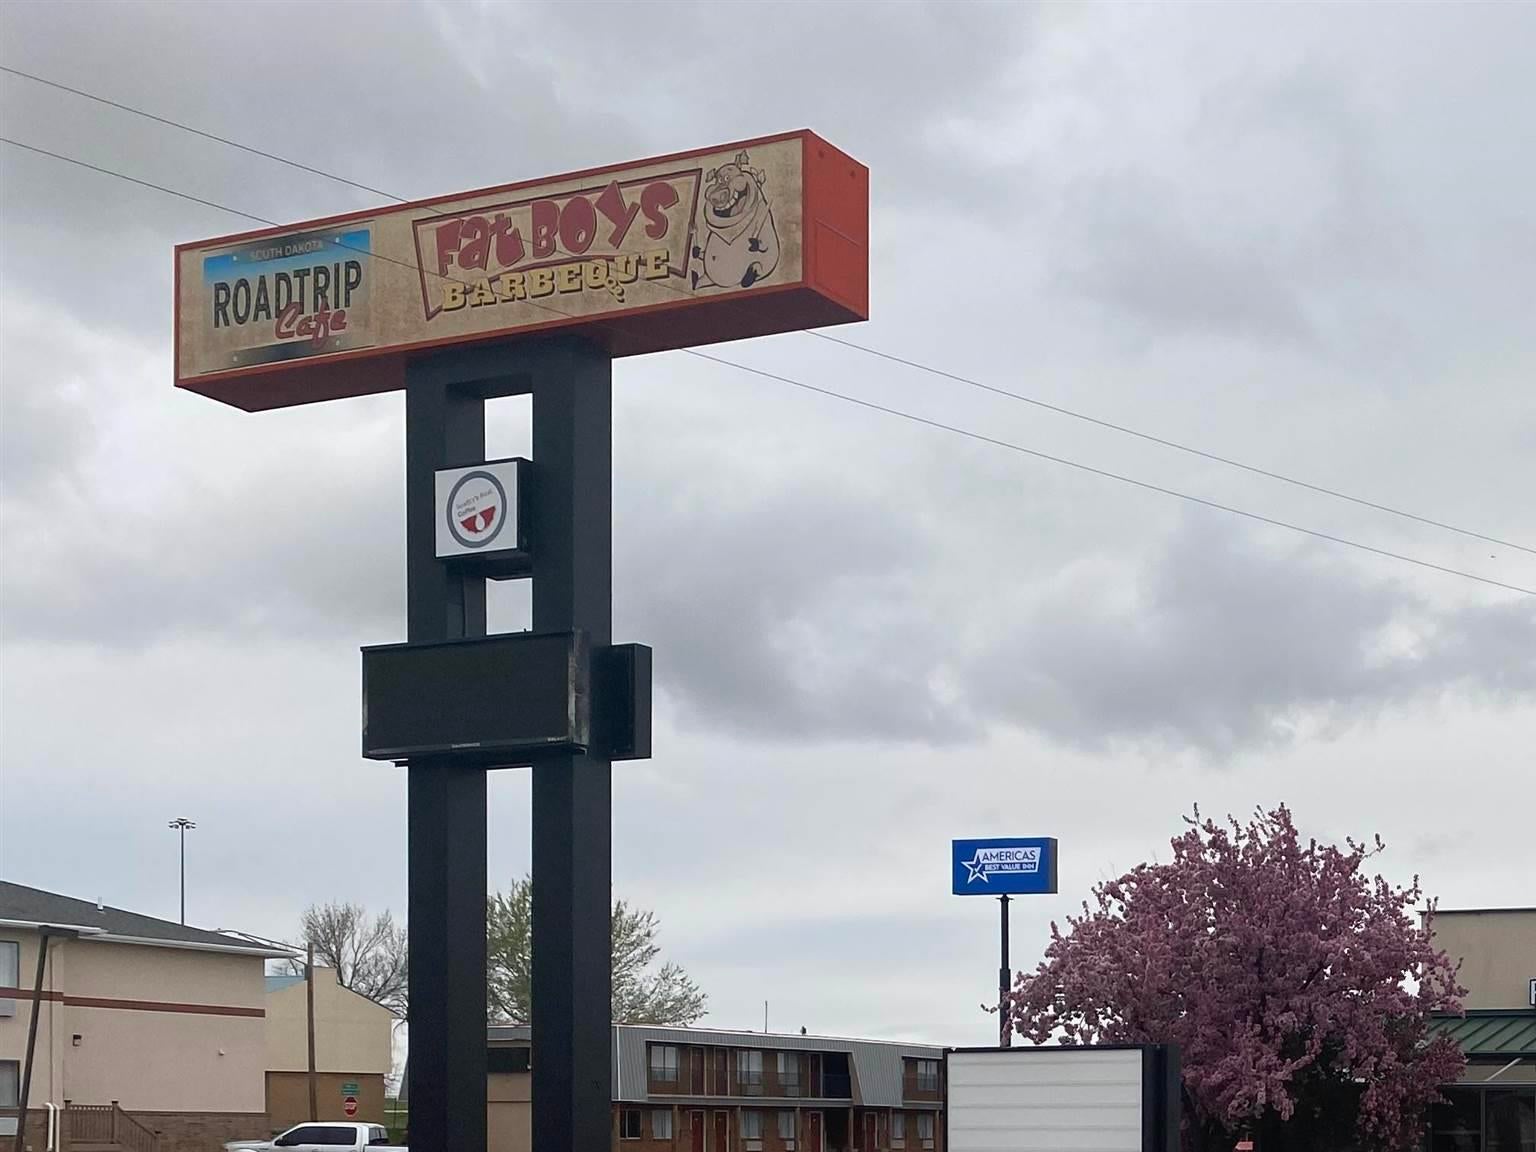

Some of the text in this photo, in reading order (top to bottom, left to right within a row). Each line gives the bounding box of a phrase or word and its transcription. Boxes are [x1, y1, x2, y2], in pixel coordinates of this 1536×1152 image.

[284, 240, 323, 256] DAKOTA
[436, 213, 526, 278] Fat
[213, 260, 362, 329] ROADTRIP
[440, 249, 670, 313] BARBEQUE
[275, 296, 347, 349] Cafe
[982, 850, 1036, 862] AMERICAS
[984, 863, 1000, 871] BEST
